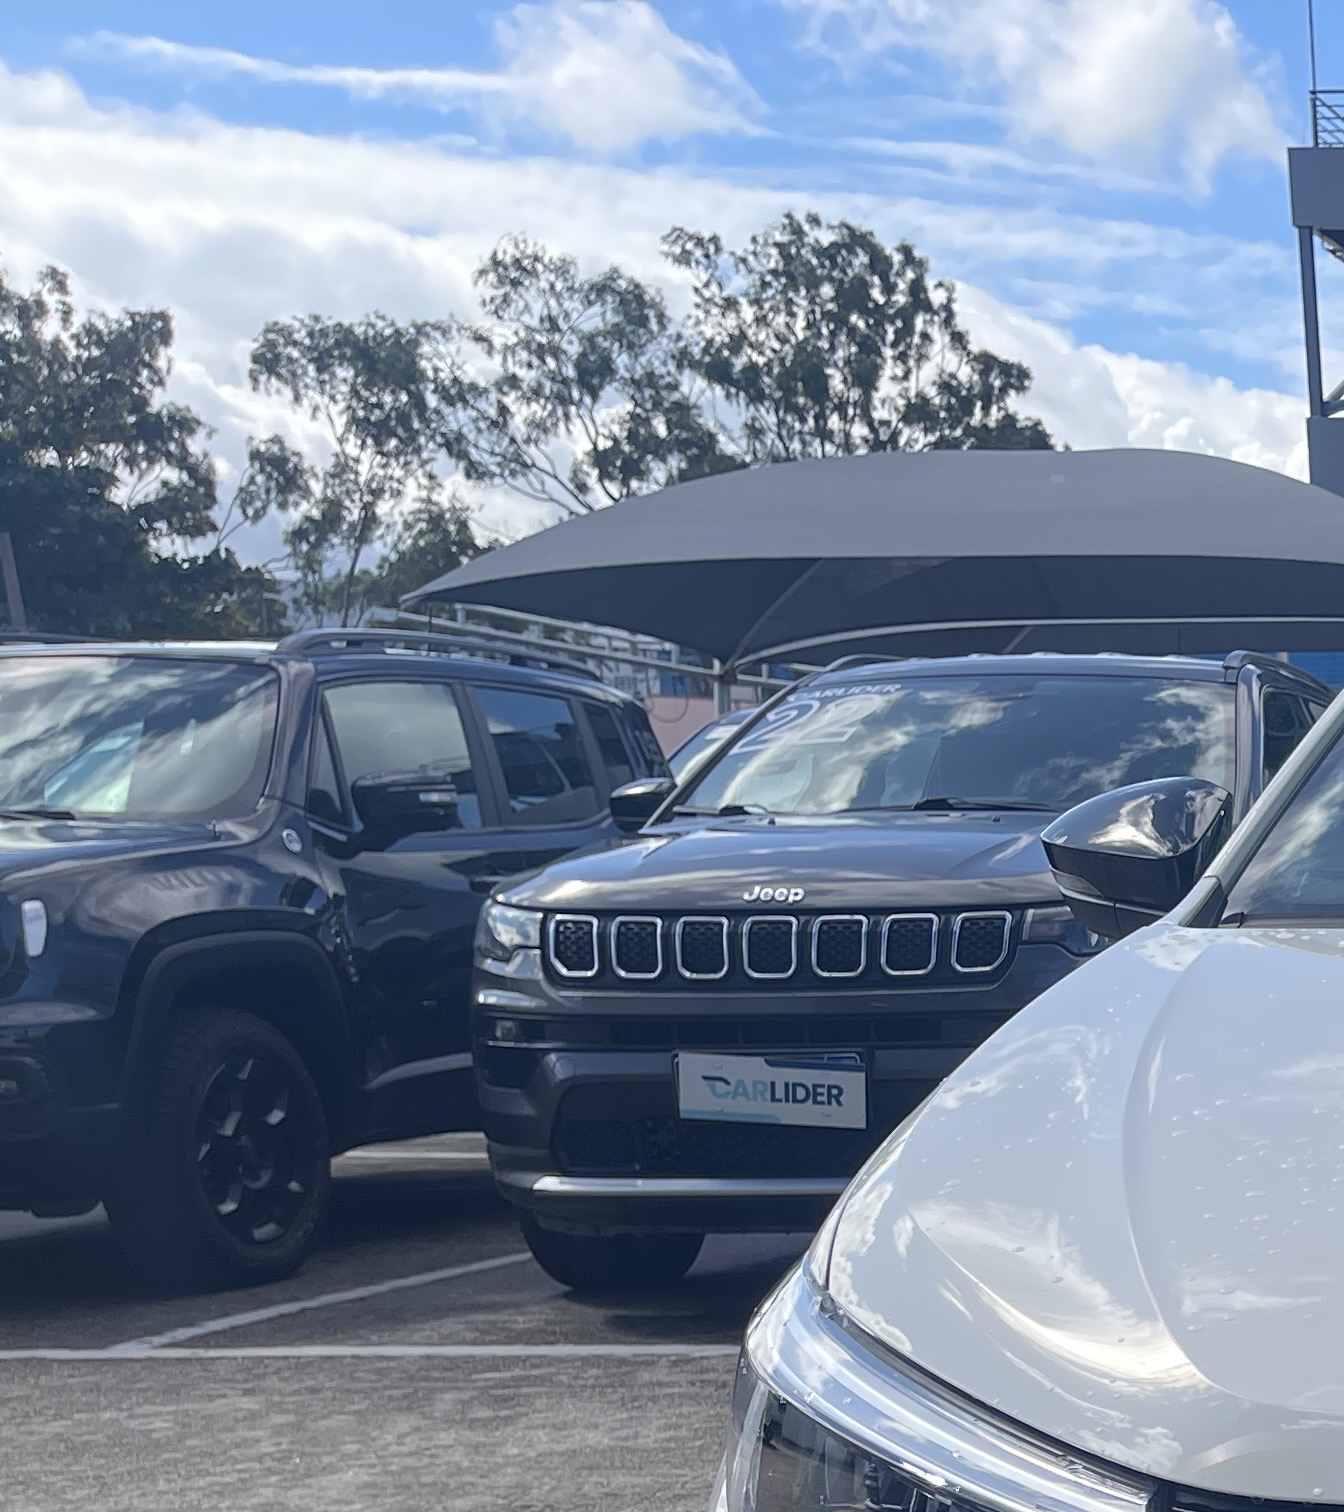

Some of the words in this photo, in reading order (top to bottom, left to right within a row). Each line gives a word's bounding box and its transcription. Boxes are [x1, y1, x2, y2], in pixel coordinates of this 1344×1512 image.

[728, 694, 883, 757] 22
[742, 884, 806, 905] Jeep
[701, 1074, 844, 1108] CARLIDER
